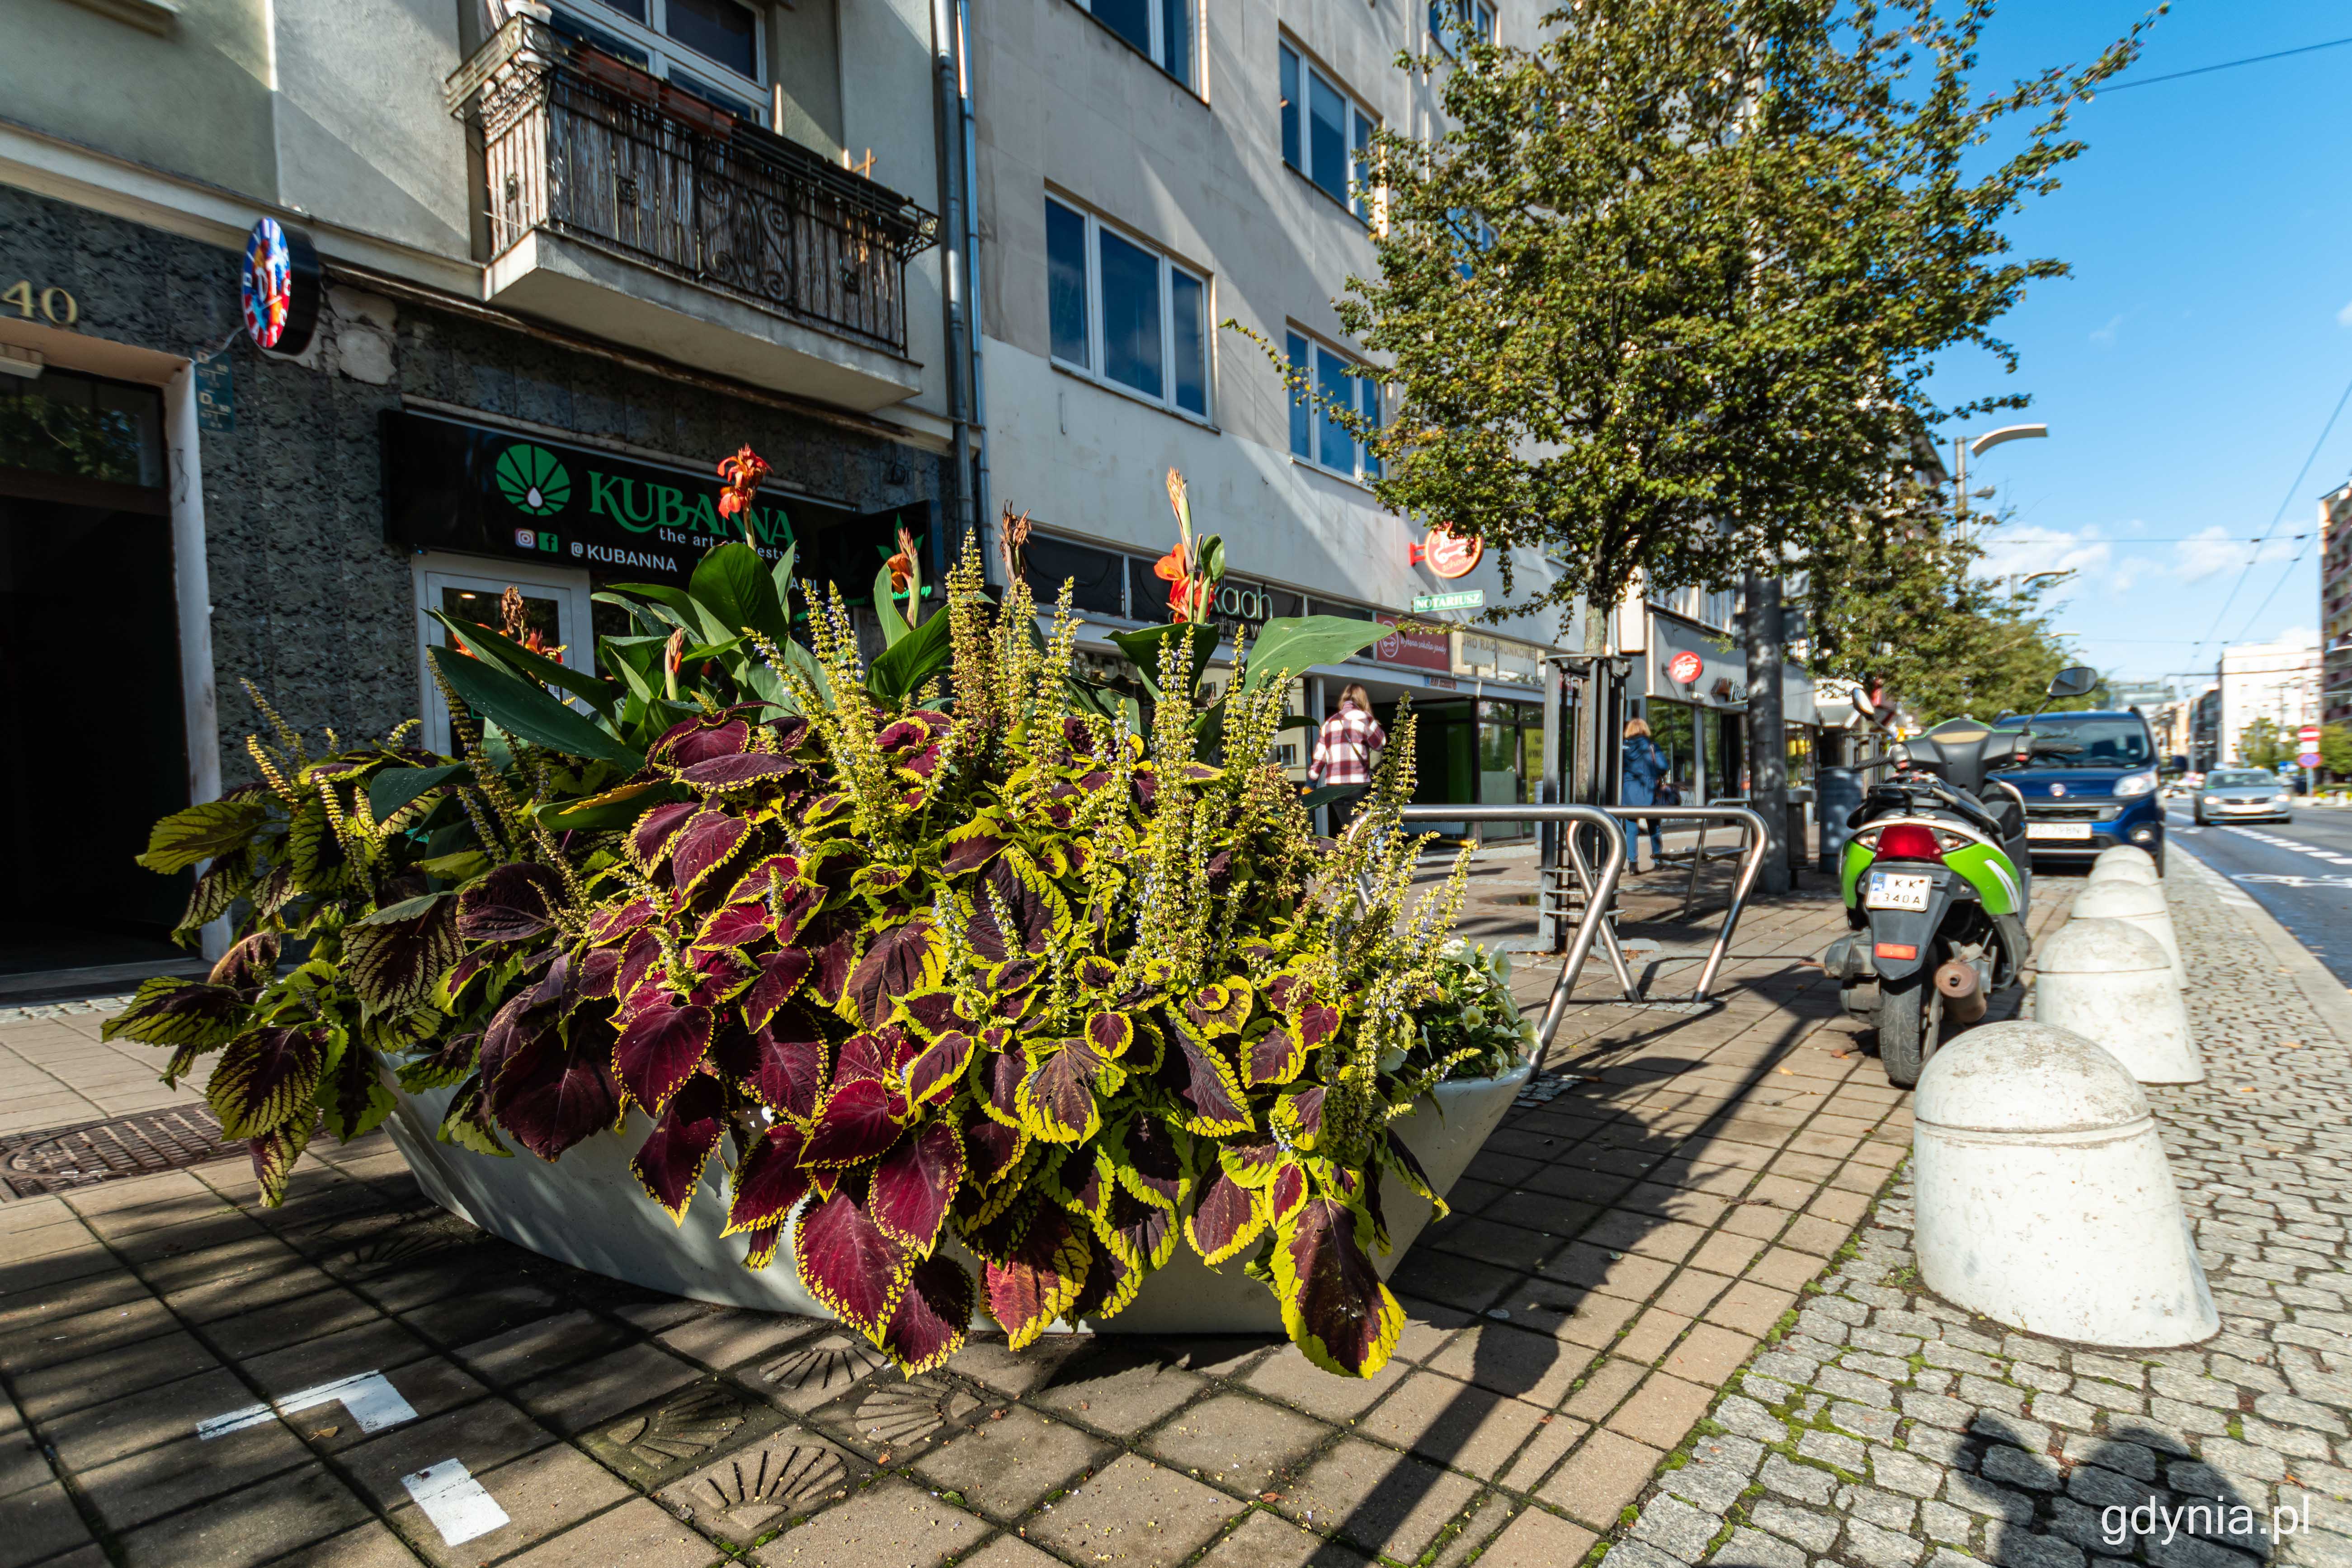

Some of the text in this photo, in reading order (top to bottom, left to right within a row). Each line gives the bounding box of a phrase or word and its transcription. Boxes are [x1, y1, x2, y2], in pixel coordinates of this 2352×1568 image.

[2, 280, 78, 324] 40
[660, 527, 685, 543] the
[693, 534, 714, 548] art
[1416, 593, 1480, 608] NOTARIUSZ
